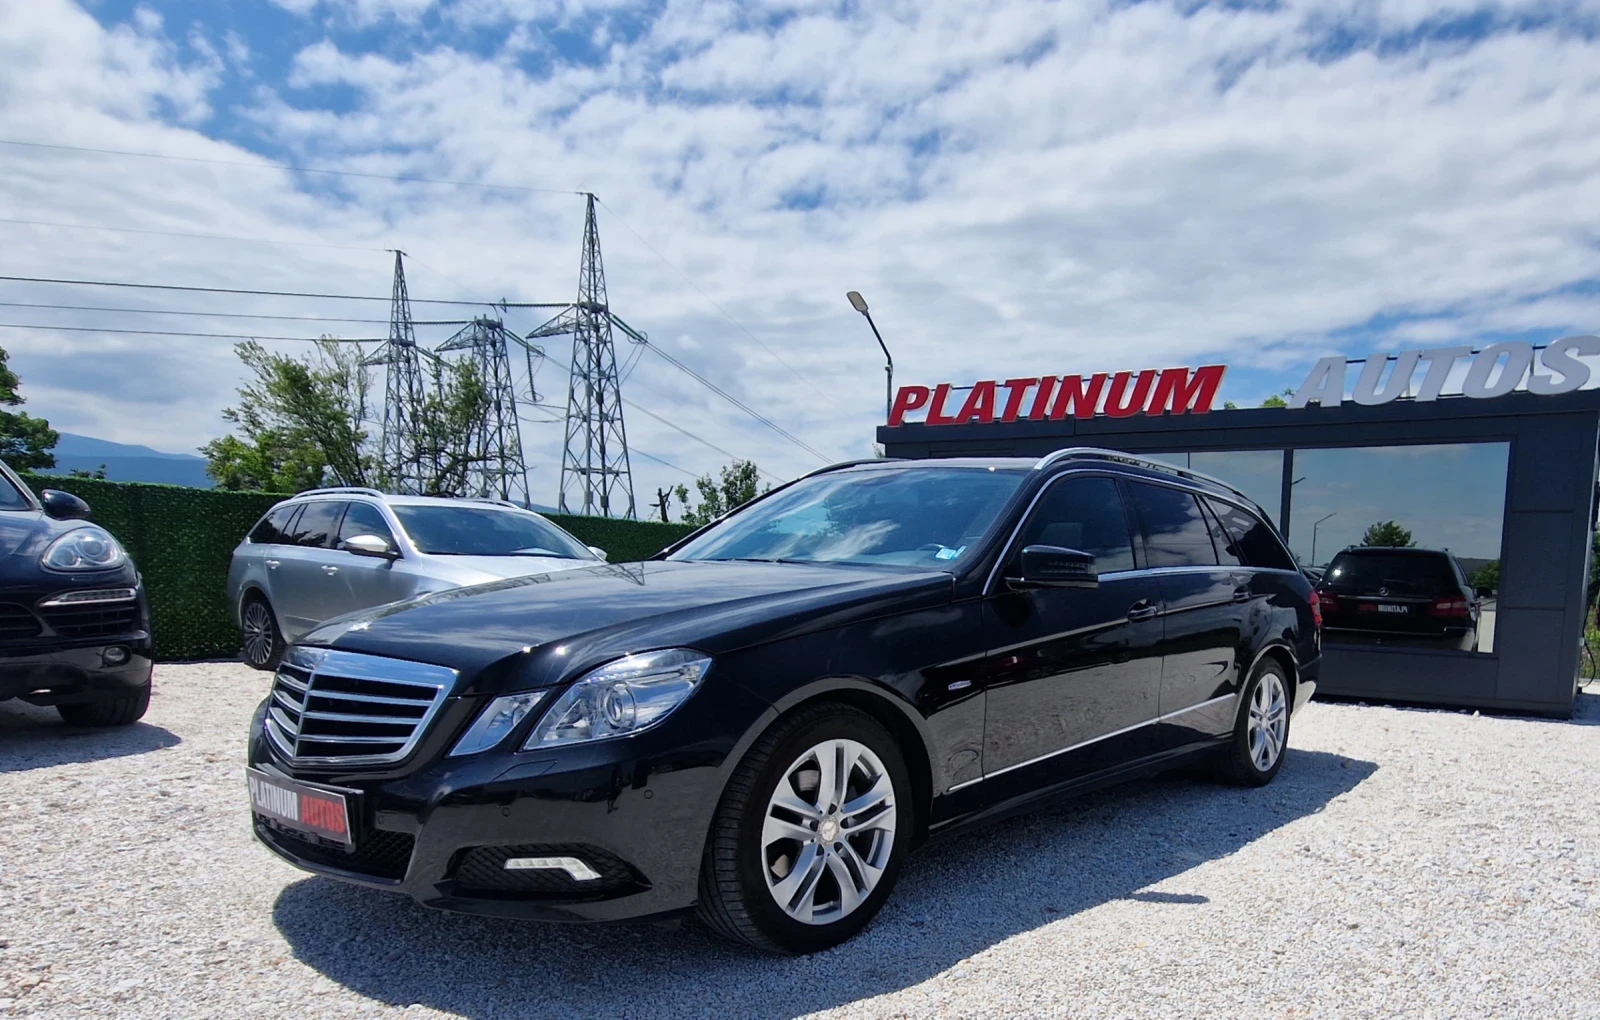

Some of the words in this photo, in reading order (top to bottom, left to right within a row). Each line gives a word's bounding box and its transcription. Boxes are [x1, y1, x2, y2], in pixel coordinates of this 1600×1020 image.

[886, 365, 1227, 428] PLATINUM
[1285, 334, 1600, 409] AUTOS
[248, 776, 298, 821] PLATINUM
[301, 794, 345, 833] AUTOS
